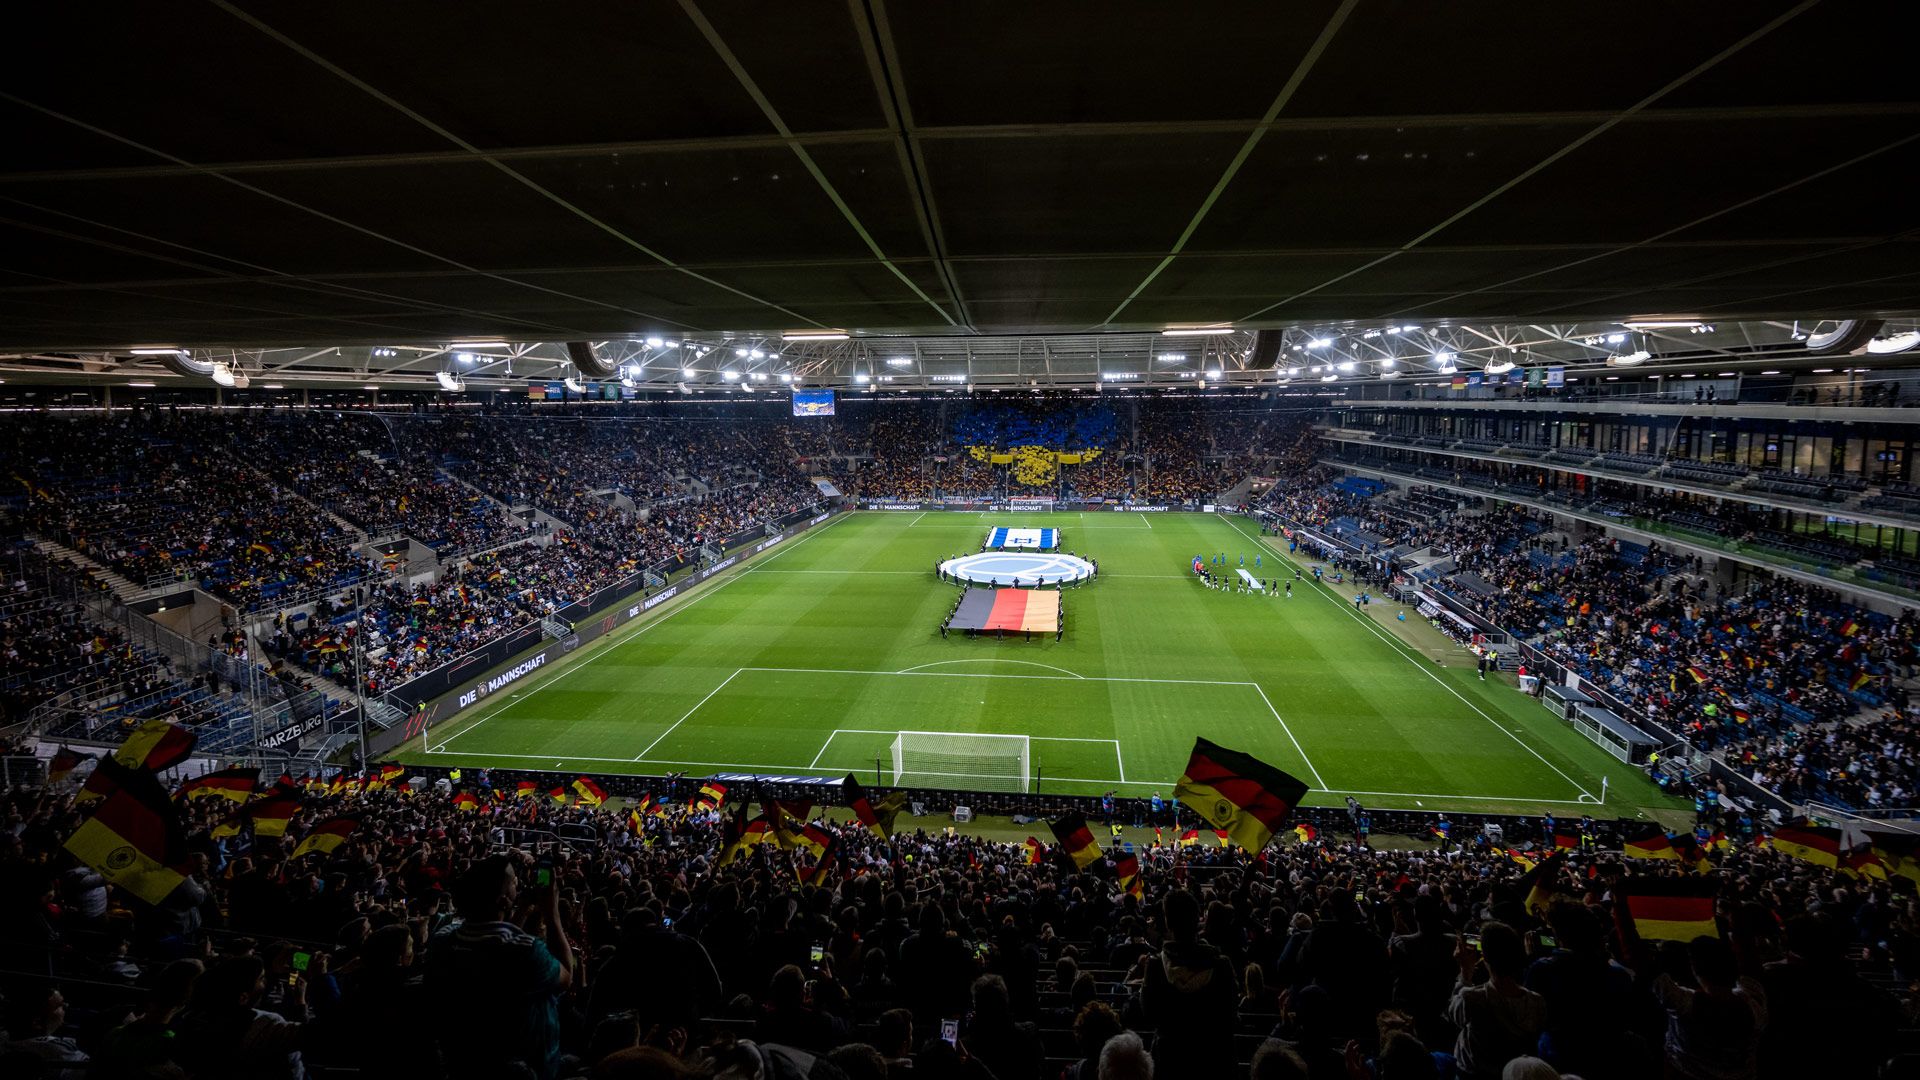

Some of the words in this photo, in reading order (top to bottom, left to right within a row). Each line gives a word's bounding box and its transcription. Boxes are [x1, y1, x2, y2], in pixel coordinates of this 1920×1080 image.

[711, 556, 736, 573] MANNSCHAFT
[629, 605, 639, 618] DIE
[644, 586, 677, 609] MANNSCHAFT
[459, 689, 477, 708] DIE
[488, 653, 546, 693] MANNSCHAFT
